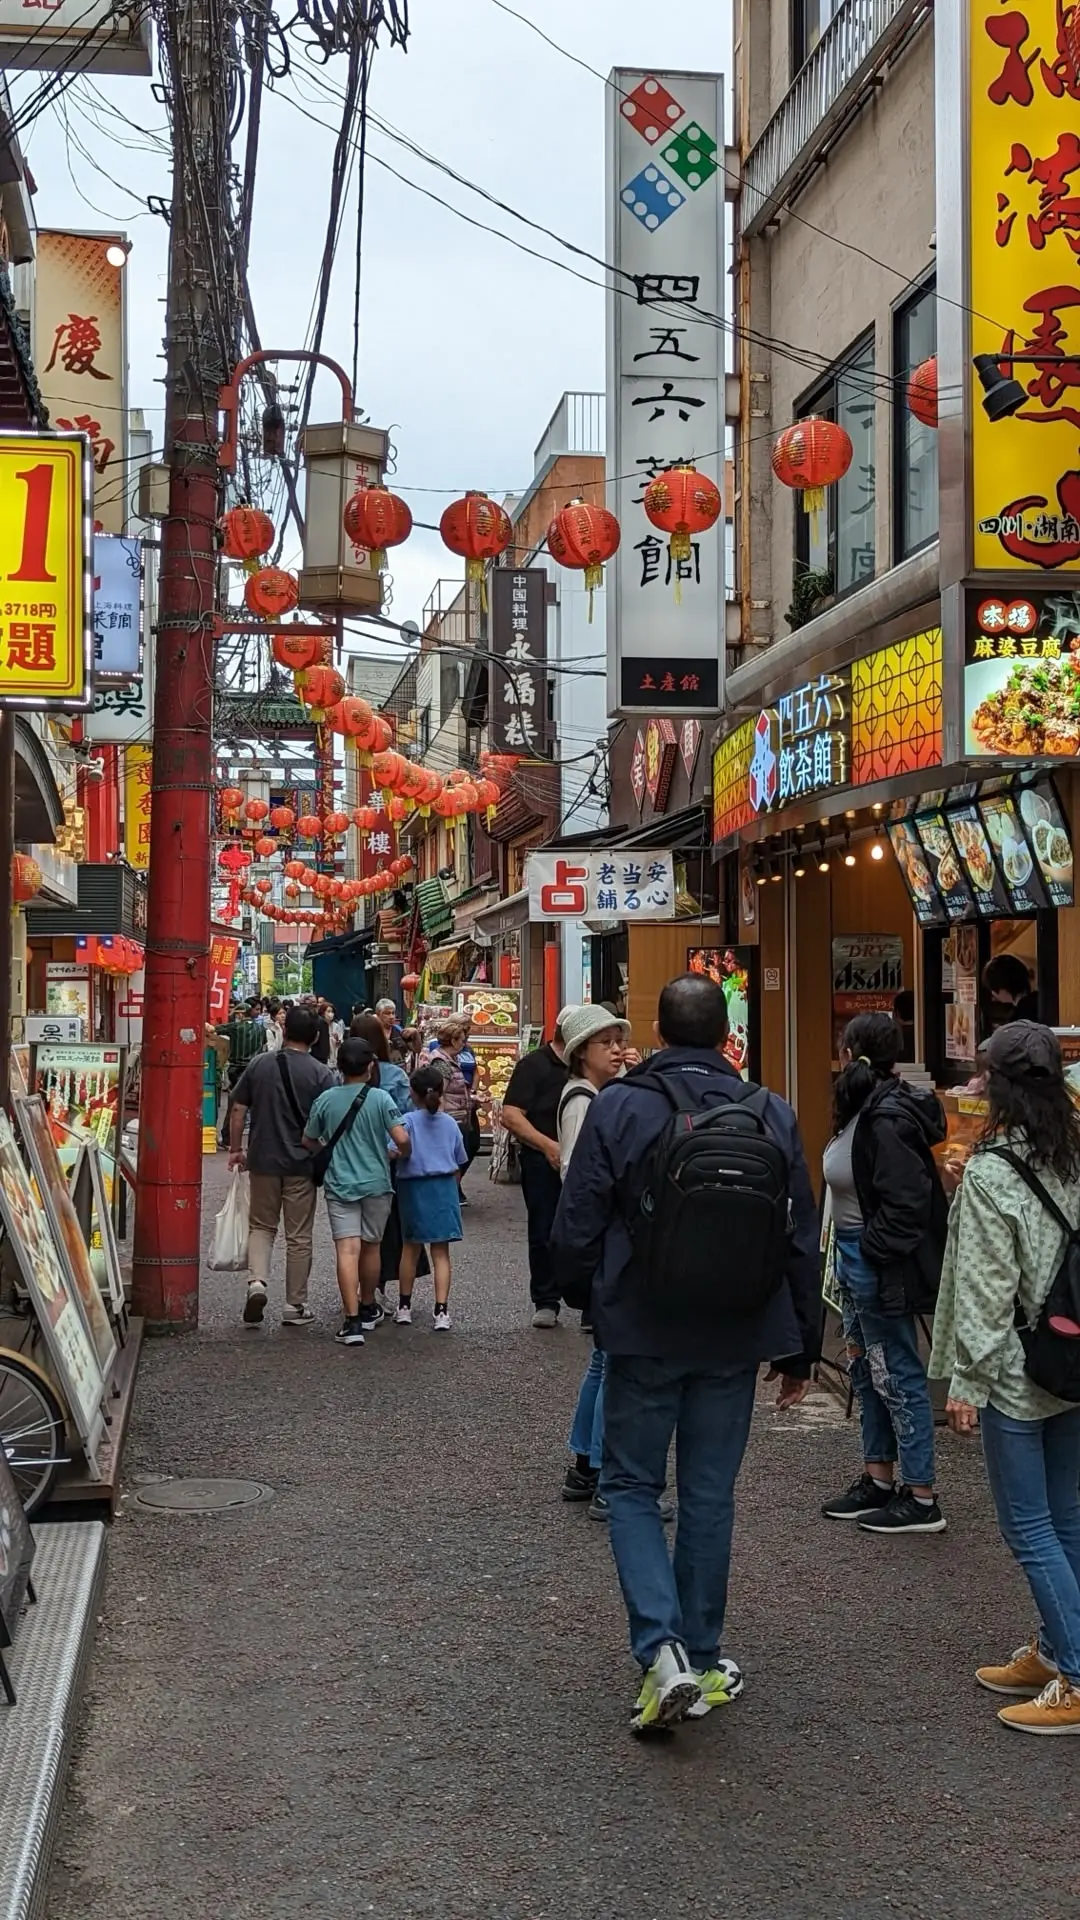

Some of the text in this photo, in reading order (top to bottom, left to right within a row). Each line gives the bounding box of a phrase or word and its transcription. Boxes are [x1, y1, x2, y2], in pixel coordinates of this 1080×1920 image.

[512, 574, 528, 631] 中国料理
[983, 604, 1031, 629] 本場
[0, 622, 57, 671] 題
[973, 635, 1062, 659] 麻婆豆腐
[640, 672, 701, 692] 土産館
[779, 731, 833, 799] 飲茶館
[541, 860, 587, 913] 占
[622, 863, 643, 911] 当る
[646, 861, 670, 906] 安心
[834, 959, 902, 991] Asahi
